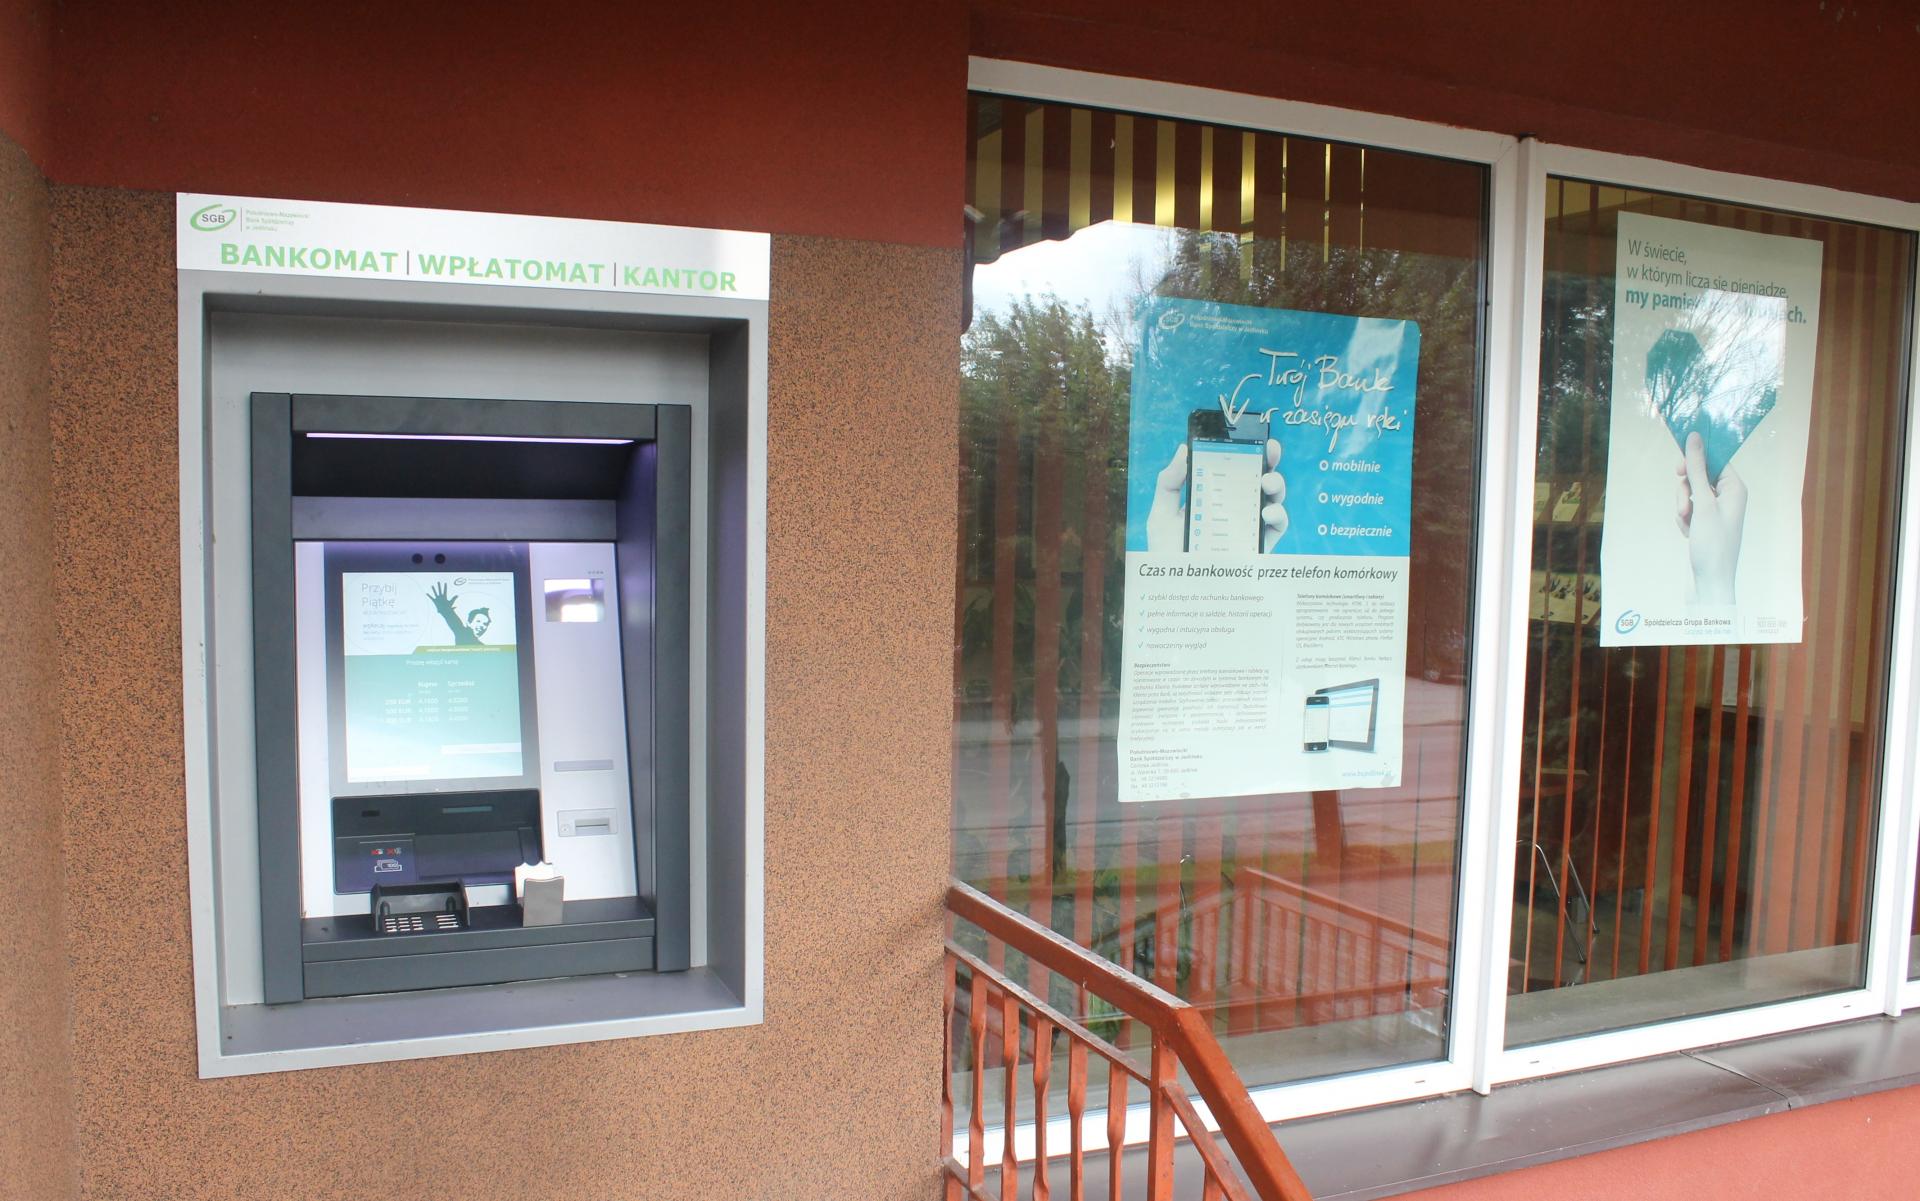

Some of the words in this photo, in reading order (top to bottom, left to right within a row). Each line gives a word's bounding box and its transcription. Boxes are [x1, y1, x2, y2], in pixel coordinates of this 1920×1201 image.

[202, 214, 225, 223] SGB
[1628, 240, 1642, 256] W
[1644, 243, 1687, 265] świecie,
[221, 243, 398, 273] BANKOMAT
[418, 254, 605, 284] WPŁATOMAT
[623, 265, 737, 292] KANTOR
[1627, 267, 1639, 279] w
[1641, 264, 1683, 286] którym
[1626, 290, 1648, 308] my
[1259, 347, 1311, 408] Twój
[1315, 354, 1395, 391] Bank
[1259, 407, 1279, 424] w
[1282, 405, 1358, 453] zasięgu
[1367, 406, 1408, 439] ręki
[1331, 460, 1381, 473] mobilnie
[1331, 492, 1384, 507] wygodnie
[1330, 523, 1392, 539] bezpiecznie
[1139, 564, 1166, 577] Czas
[1169, 567, 1185, 578] na
[1187, 564, 1253, 579] bankowość
[1257, 567, 1288, 581] przez
[1290, 565, 1331, 579] telefon
[1333, 566, 1398, 582] komórkowy
[1620, 619, 1634, 627] SGB
[1644, 618, 1682, 627] Spółdzielcza
[1684, 618, 1702, 627] Grupa
[1703, 618, 1731, 626] Bankowa
